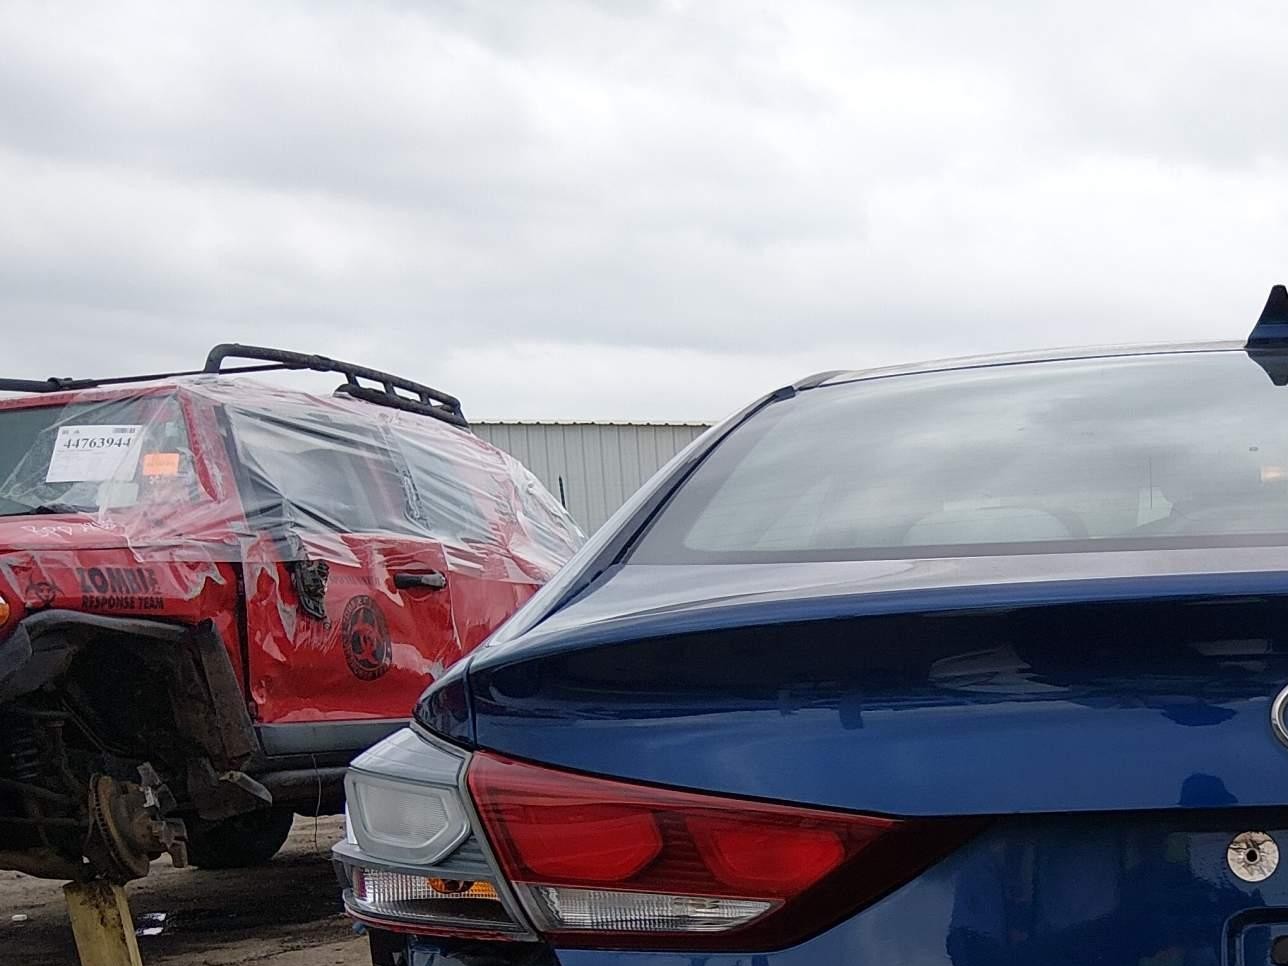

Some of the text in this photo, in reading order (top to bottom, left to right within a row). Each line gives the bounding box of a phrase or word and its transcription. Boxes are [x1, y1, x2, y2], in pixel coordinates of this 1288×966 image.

[63, 437, 132, 449] 44763944
[81, 595, 164, 609] RESPONSE TEAM
